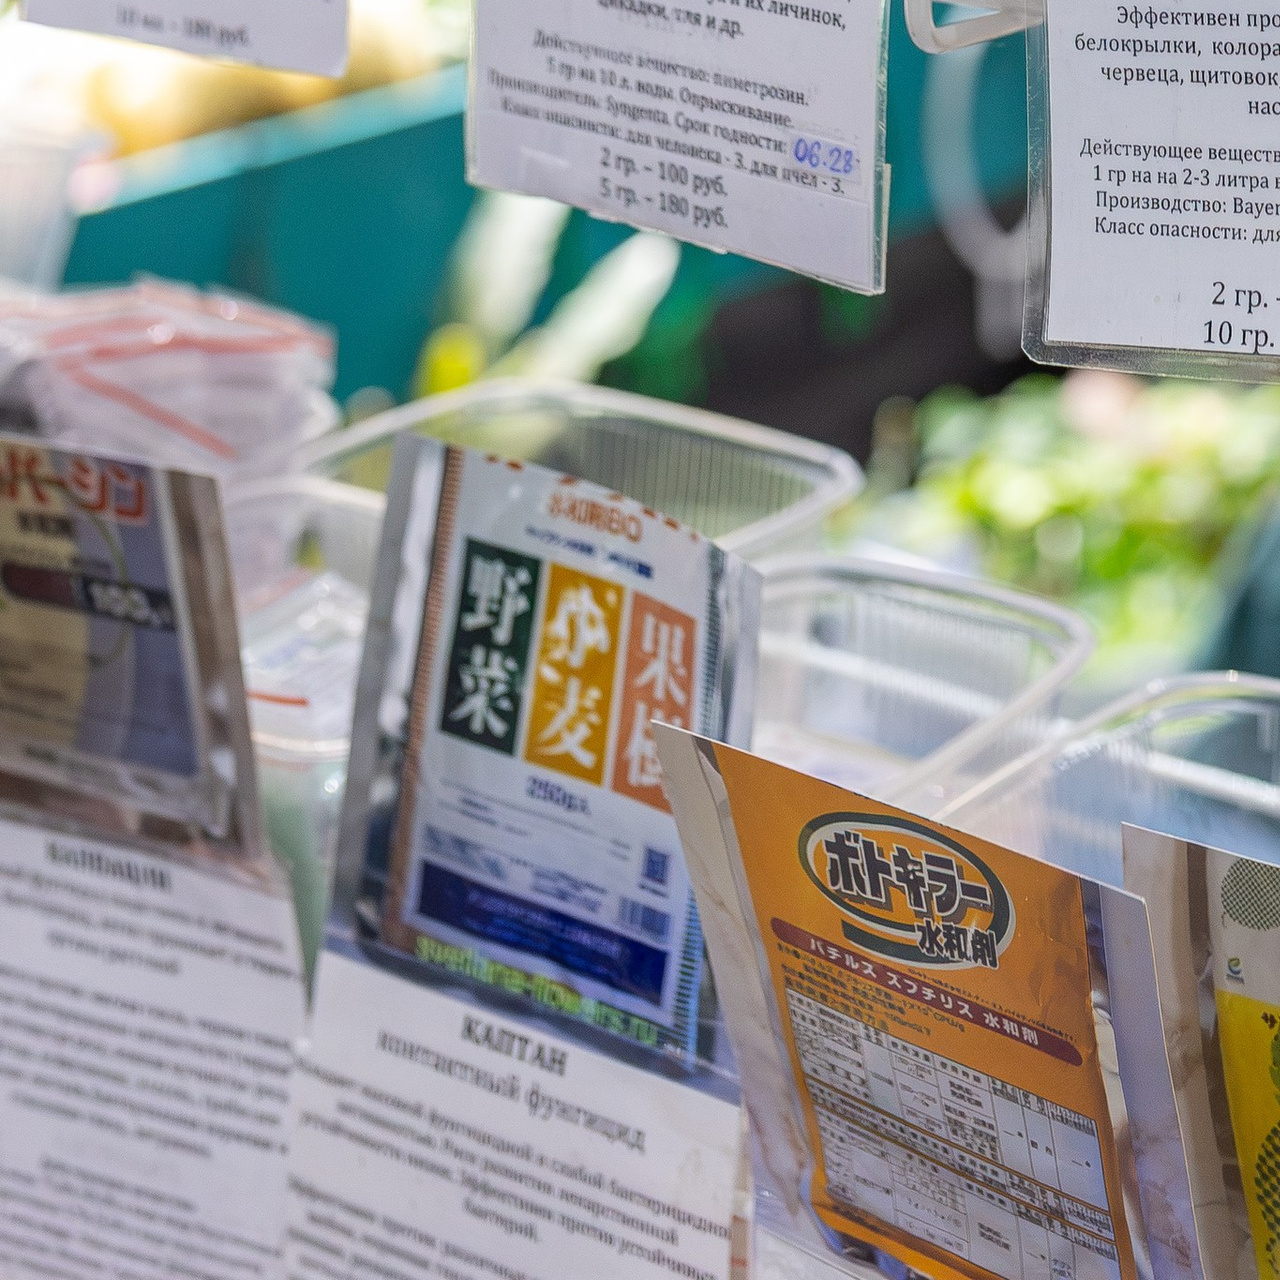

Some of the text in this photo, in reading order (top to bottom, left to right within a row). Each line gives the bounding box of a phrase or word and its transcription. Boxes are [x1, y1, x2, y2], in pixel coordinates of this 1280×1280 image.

[1117, 5, 1240, 30] Эффективен
[1075, 32, 1201, 57] белокрылки,
[1101, 67, 1184, 86] червеца,
[1096, 190, 1226, 214] Производство:
[1212, 281, 1225, 306] 2
[1235, 289, 1268, 314] гр.
[1204, 320, 1232, 355] 10
[1241, 329, 1274, 357] гр.
[823, 829, 992, 917] ボトキラー
